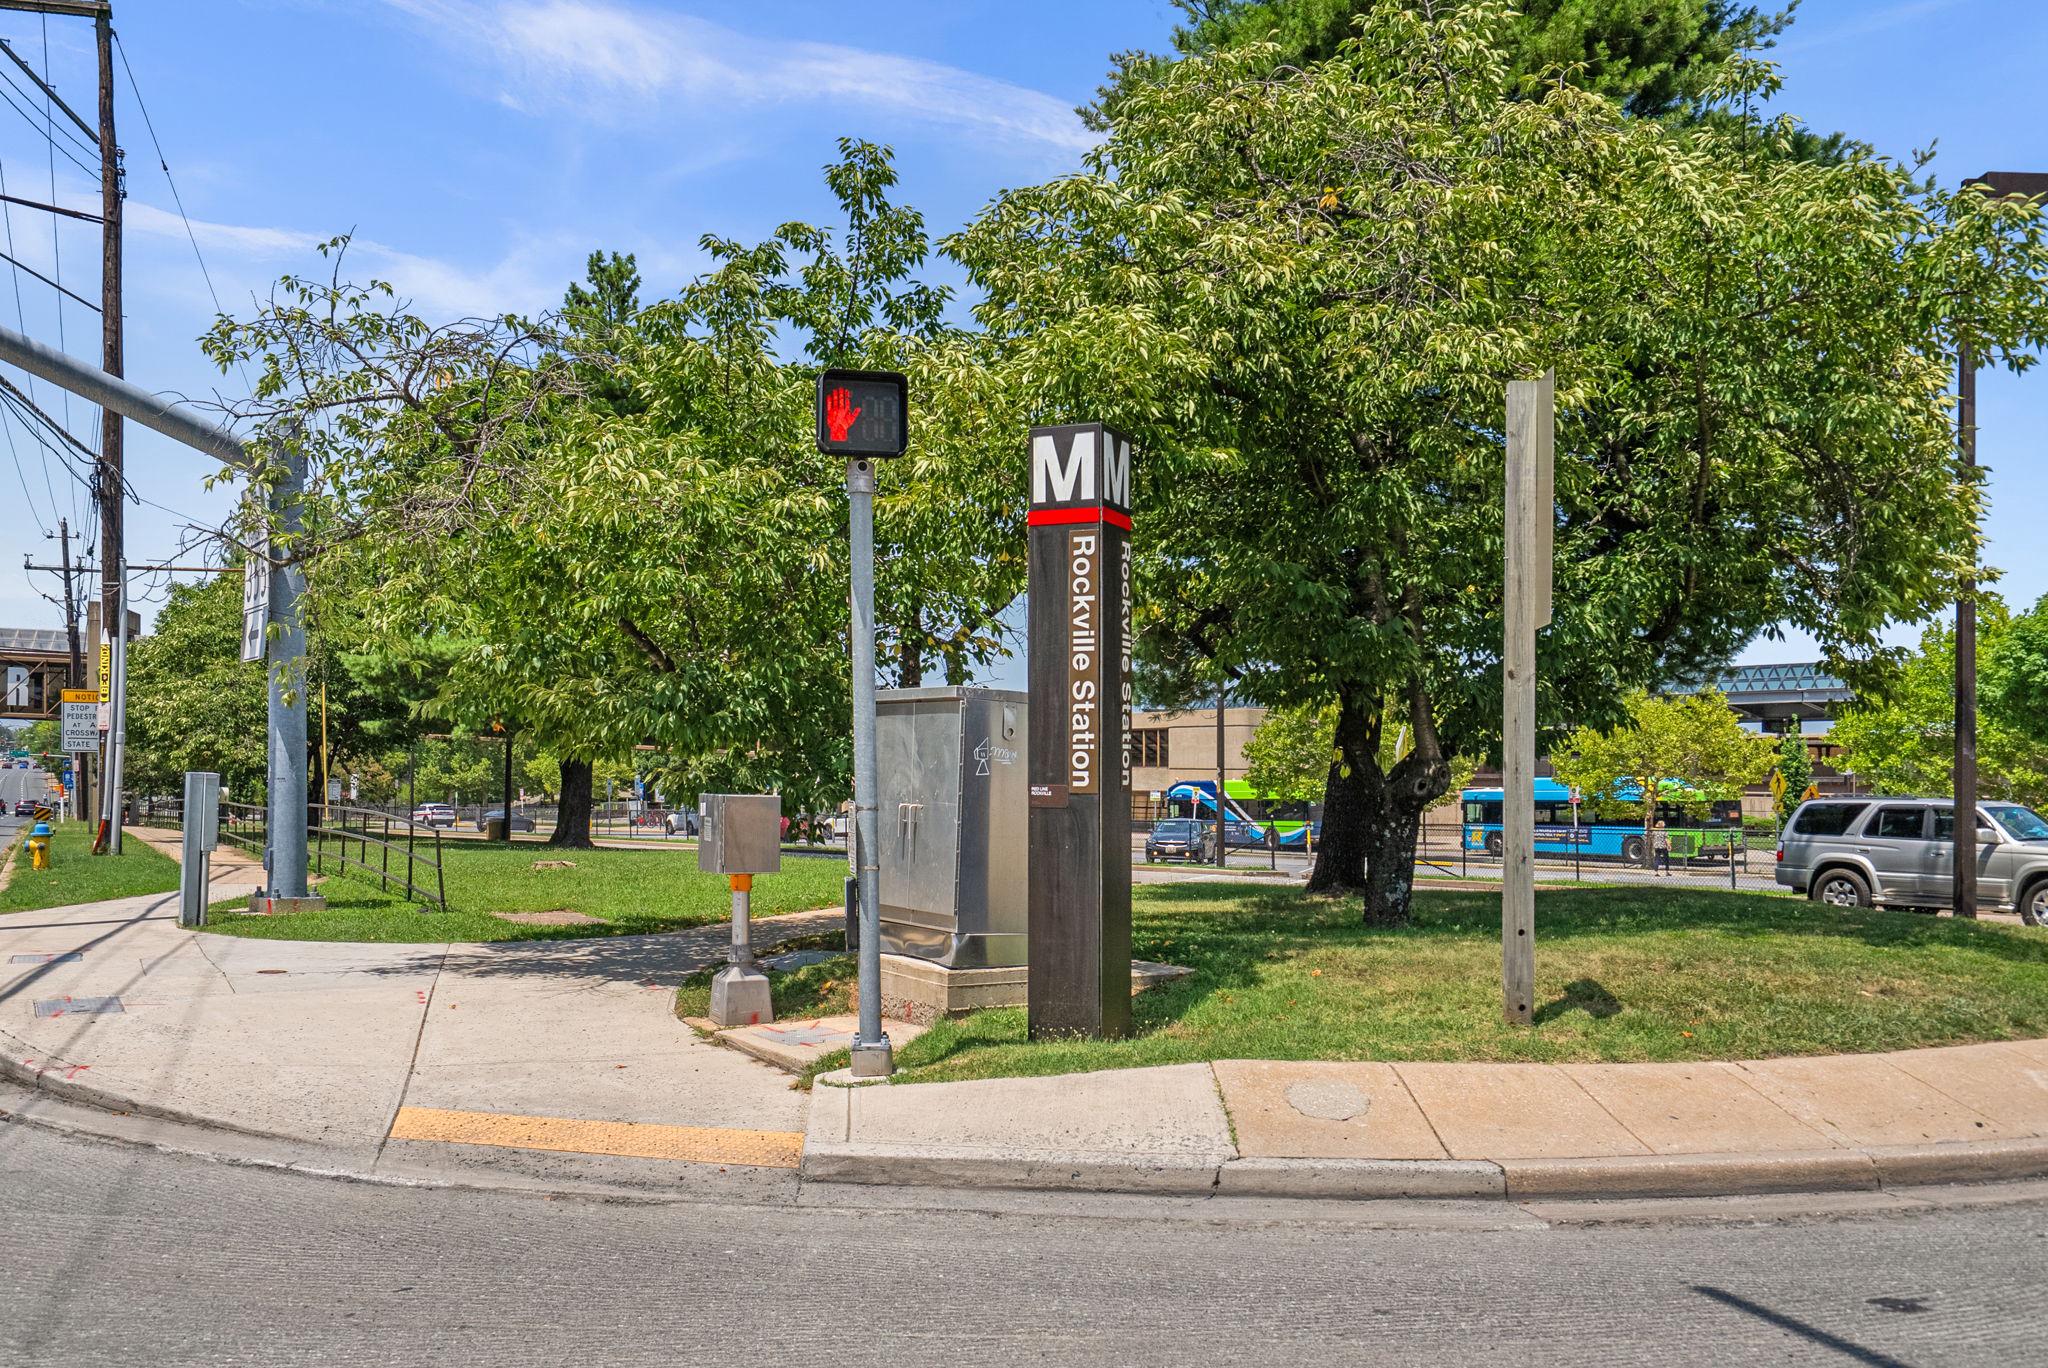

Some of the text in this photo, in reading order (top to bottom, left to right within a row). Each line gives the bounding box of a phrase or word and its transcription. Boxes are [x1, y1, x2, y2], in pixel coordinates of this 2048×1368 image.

[1033, 431, 1095, 504] M
[1103, 430, 1130, 510] M
[7, 666, 30, 707] R
[1072, 535, 1096, 787] Rockville Station
[1121, 540, 1132, 786] Rockville Station
[67, 740, 91, 748] STATE
